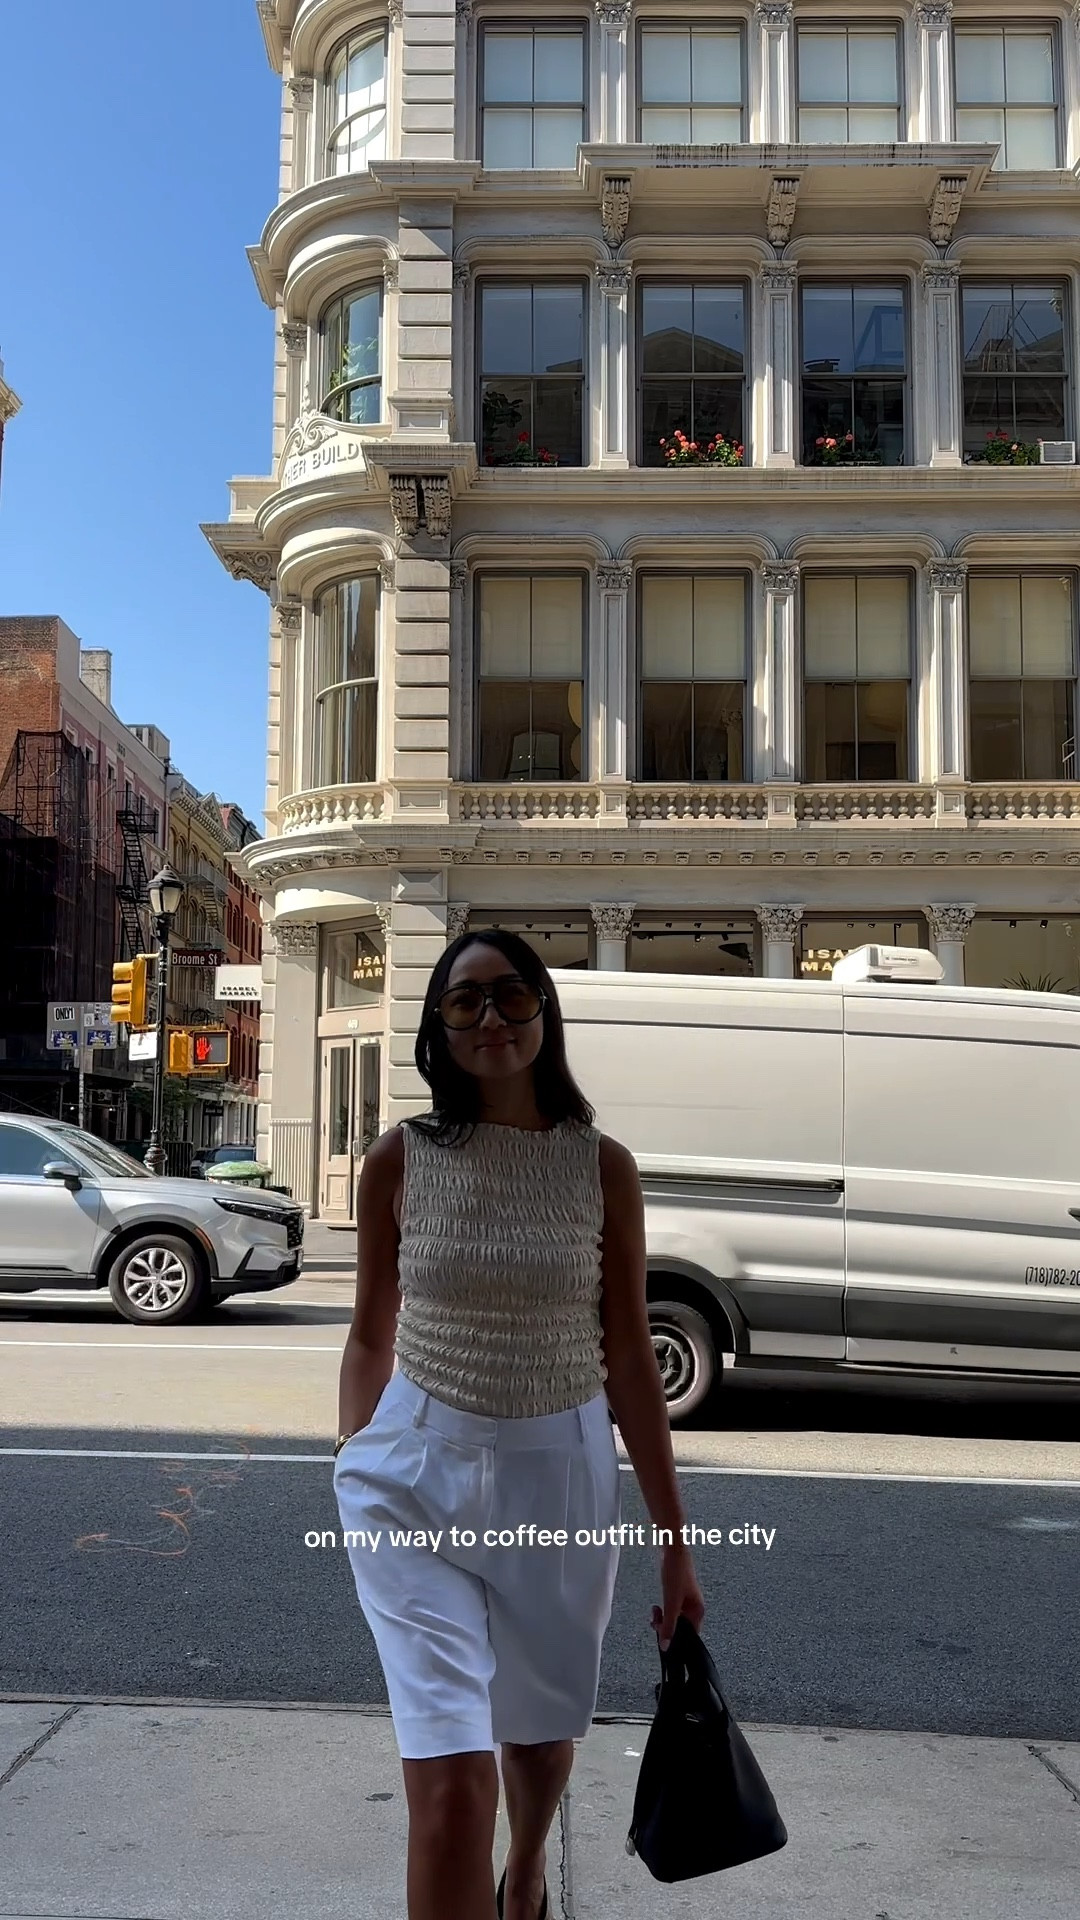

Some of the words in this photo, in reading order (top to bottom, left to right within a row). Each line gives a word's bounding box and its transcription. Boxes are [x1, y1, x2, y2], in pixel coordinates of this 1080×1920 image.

[172, 952, 205, 965] Broome
[208, 953, 218, 965] St
[807, 949, 851, 959] ISA
[353, 967, 383, 979] MAR
